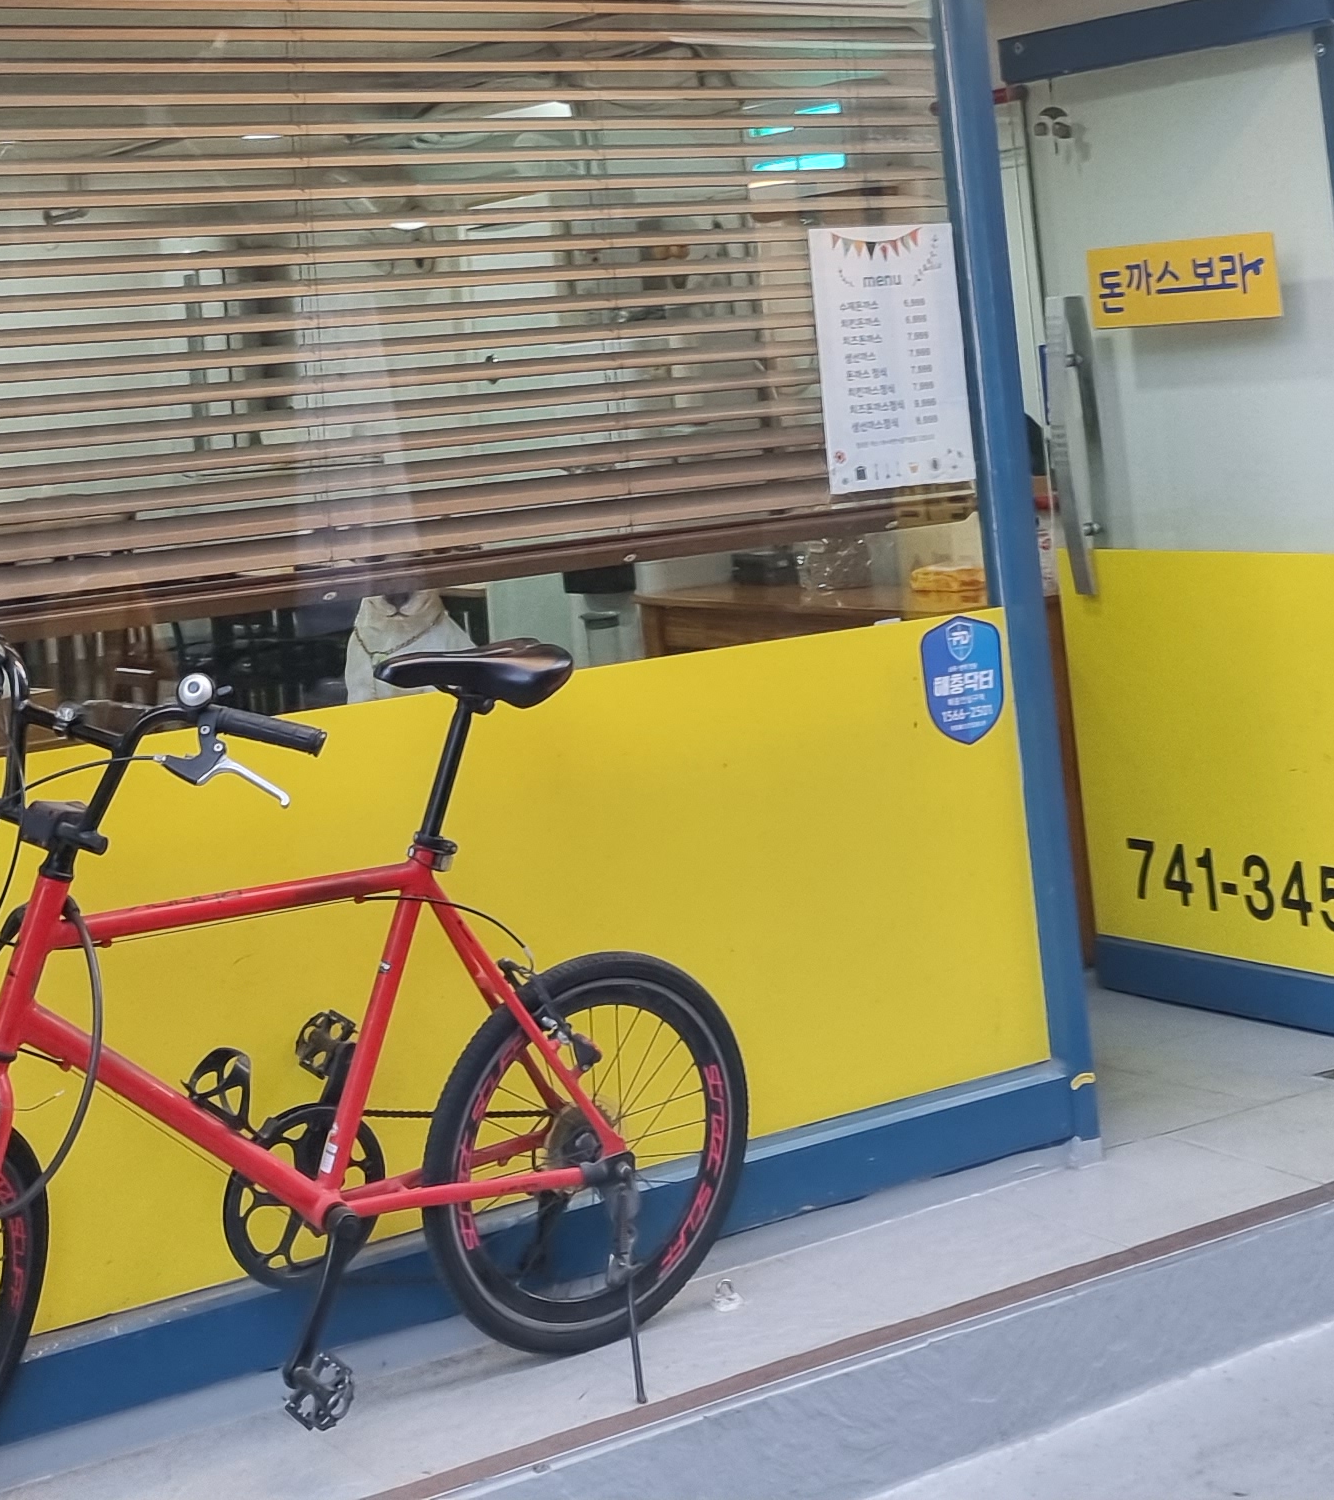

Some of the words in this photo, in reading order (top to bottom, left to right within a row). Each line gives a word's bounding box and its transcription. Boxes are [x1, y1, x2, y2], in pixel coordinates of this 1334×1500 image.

[862, 274, 902, 288] menu
[1099, 259, 1183, 314] 돈까스
[1192, 252, 1265, 295] 보라
